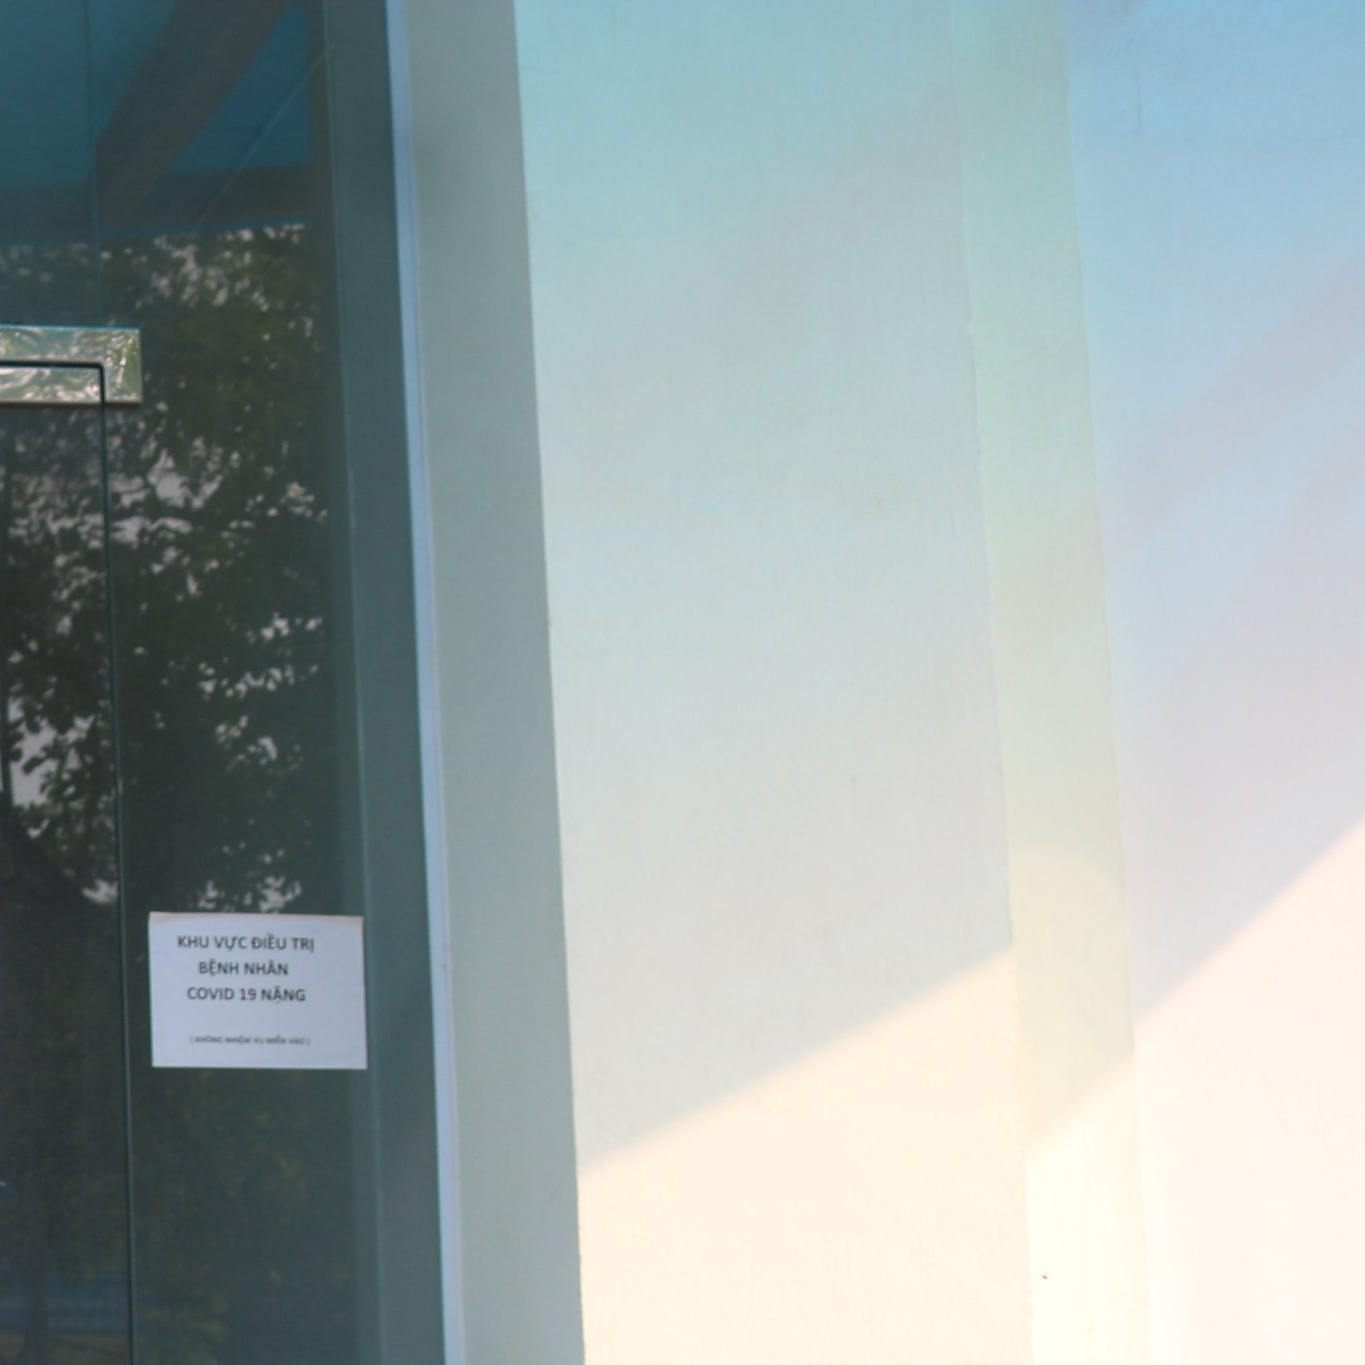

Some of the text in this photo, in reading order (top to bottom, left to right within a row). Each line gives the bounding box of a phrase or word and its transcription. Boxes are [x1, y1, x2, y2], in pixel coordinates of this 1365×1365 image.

[177, 931, 315, 953] KHU VỰC ĐIỀU TRỊ
[198, 958, 289, 977] BỆNH NHÂN
[186, 985, 307, 1004] COVID 19 NẶNG
